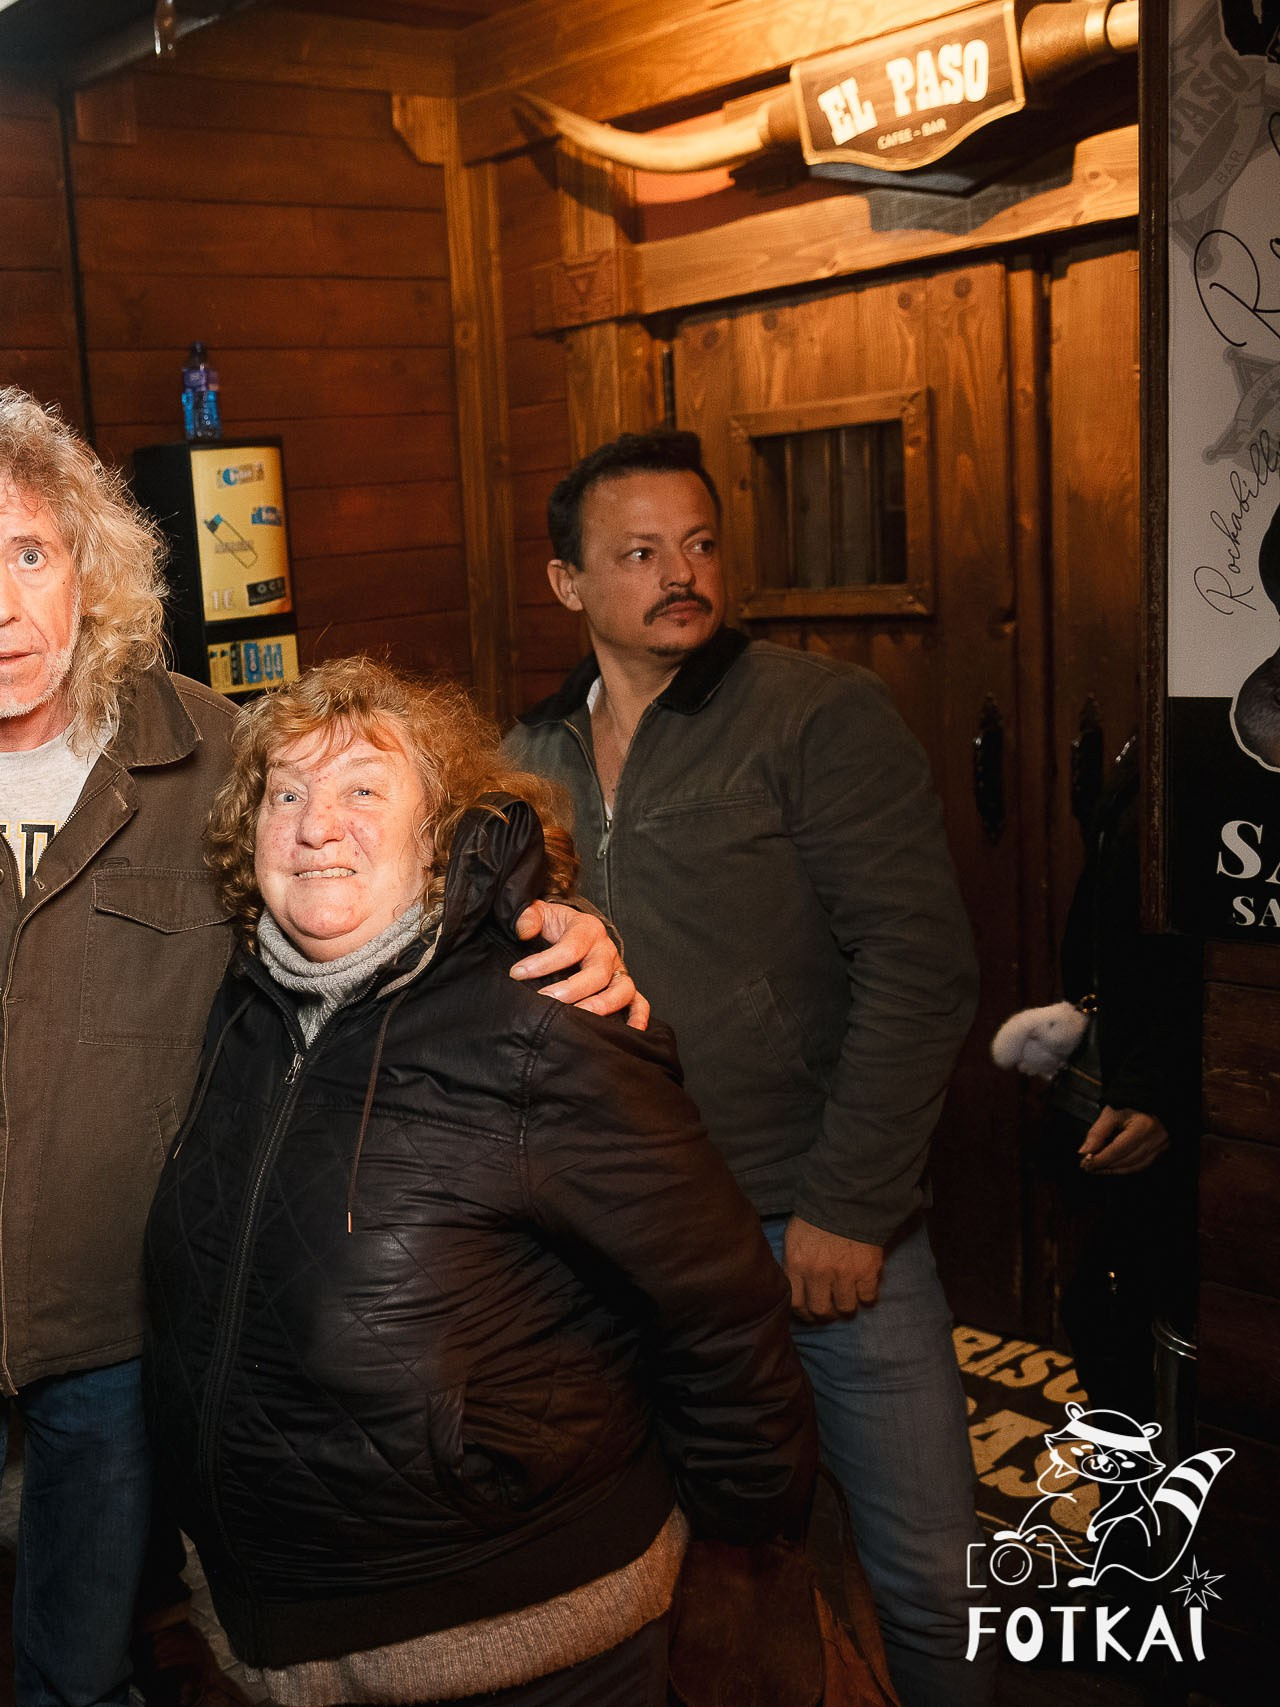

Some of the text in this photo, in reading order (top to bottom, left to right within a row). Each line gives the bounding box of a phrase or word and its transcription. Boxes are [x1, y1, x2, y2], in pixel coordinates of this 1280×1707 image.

[817, 39, 989, 146] EL PASO
[921, 118, 947, 137] BAR
[1214, 149, 1245, 185] BAR
